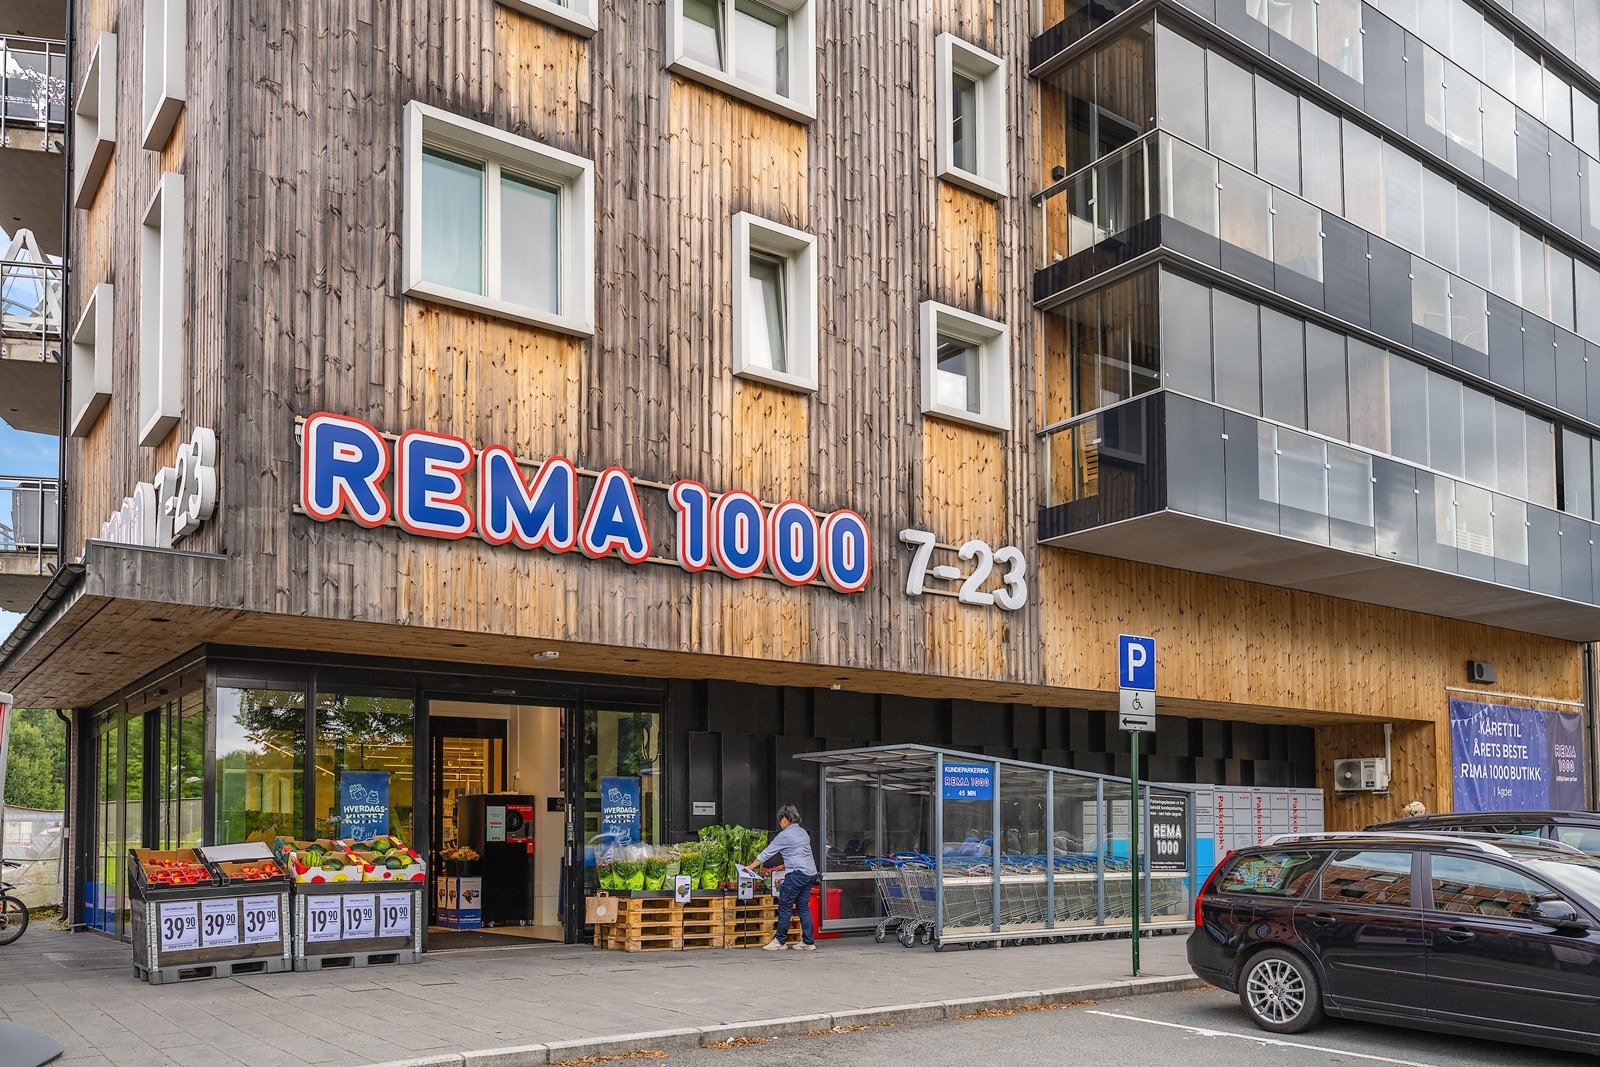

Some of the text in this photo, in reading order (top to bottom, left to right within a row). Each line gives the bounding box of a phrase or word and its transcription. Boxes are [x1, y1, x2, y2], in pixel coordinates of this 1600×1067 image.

[302, 412, 872, 593] REMA 1000
[899, 528, 1028, 610] 7-23
[1128, 642, 1147, 682] P
[1473, 738, 1528, 759] ÅRETS BESTE
[1554, 744, 1576, 758] REMA
[1460, 763, 1542, 781] REMA 1000 BUTIKK
[1558, 760, 1575, 773] 1000
[944, 777, 989, 787] REMA 1000
[1497, 787, 1513, 798] Agder
[1153, 823, 1182, 839] REMA
[1157, 840, 1179, 855] 1000
[164, 916, 196, 940] 39 90
[205, 913, 236, 936] 39 90
[246, 910, 276, 933] 39 90
[311, 910, 338, 932] 19 90
[346, 908, 372, 930] 19 90
[383, 906, 408, 928] 19 90
